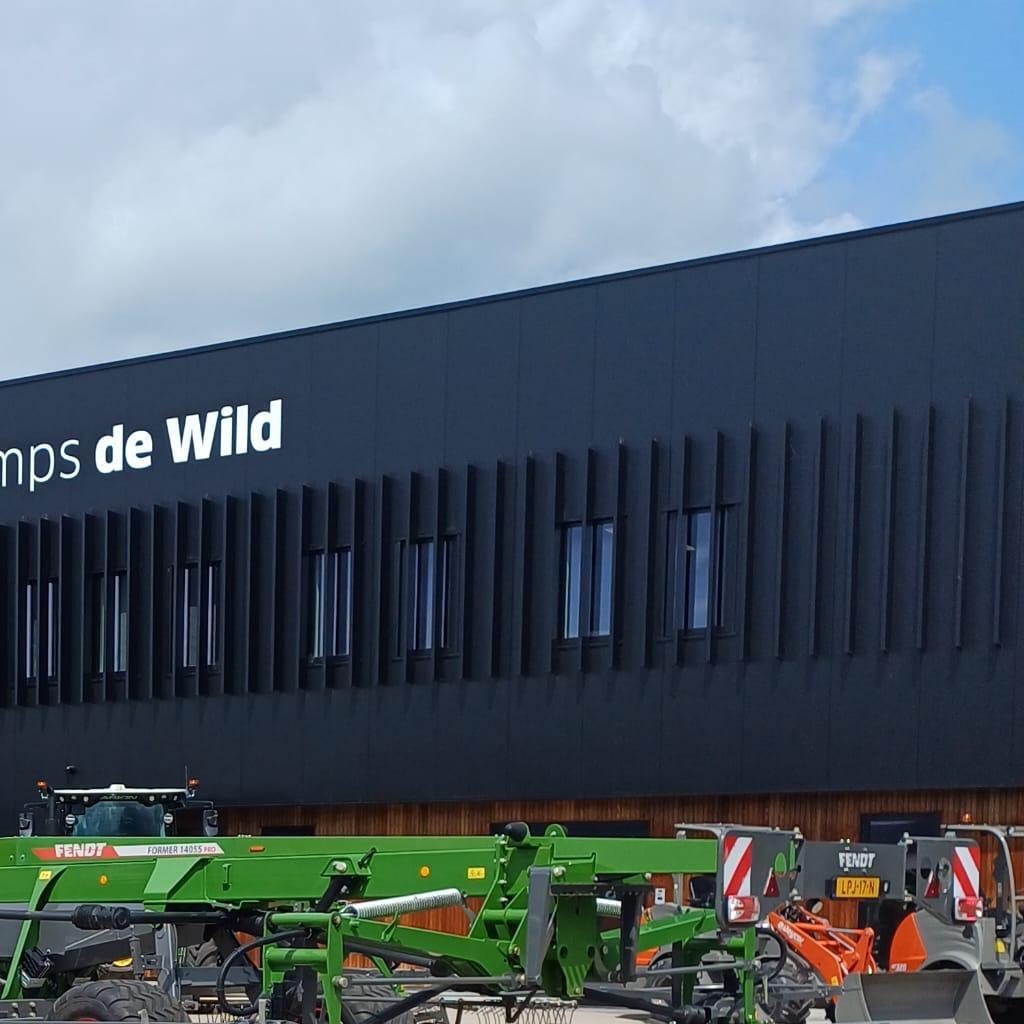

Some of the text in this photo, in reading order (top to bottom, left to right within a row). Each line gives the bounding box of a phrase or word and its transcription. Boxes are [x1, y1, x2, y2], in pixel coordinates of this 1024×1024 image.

[95, 424, 153, 474] de
[166, 399, 283, 463] Wild
[54, 843, 107, 858] FENDT
[147, 846, 178, 855] FORMER
[179, 845, 203, 854] 14055
[838, 852, 876, 868] FENDT
